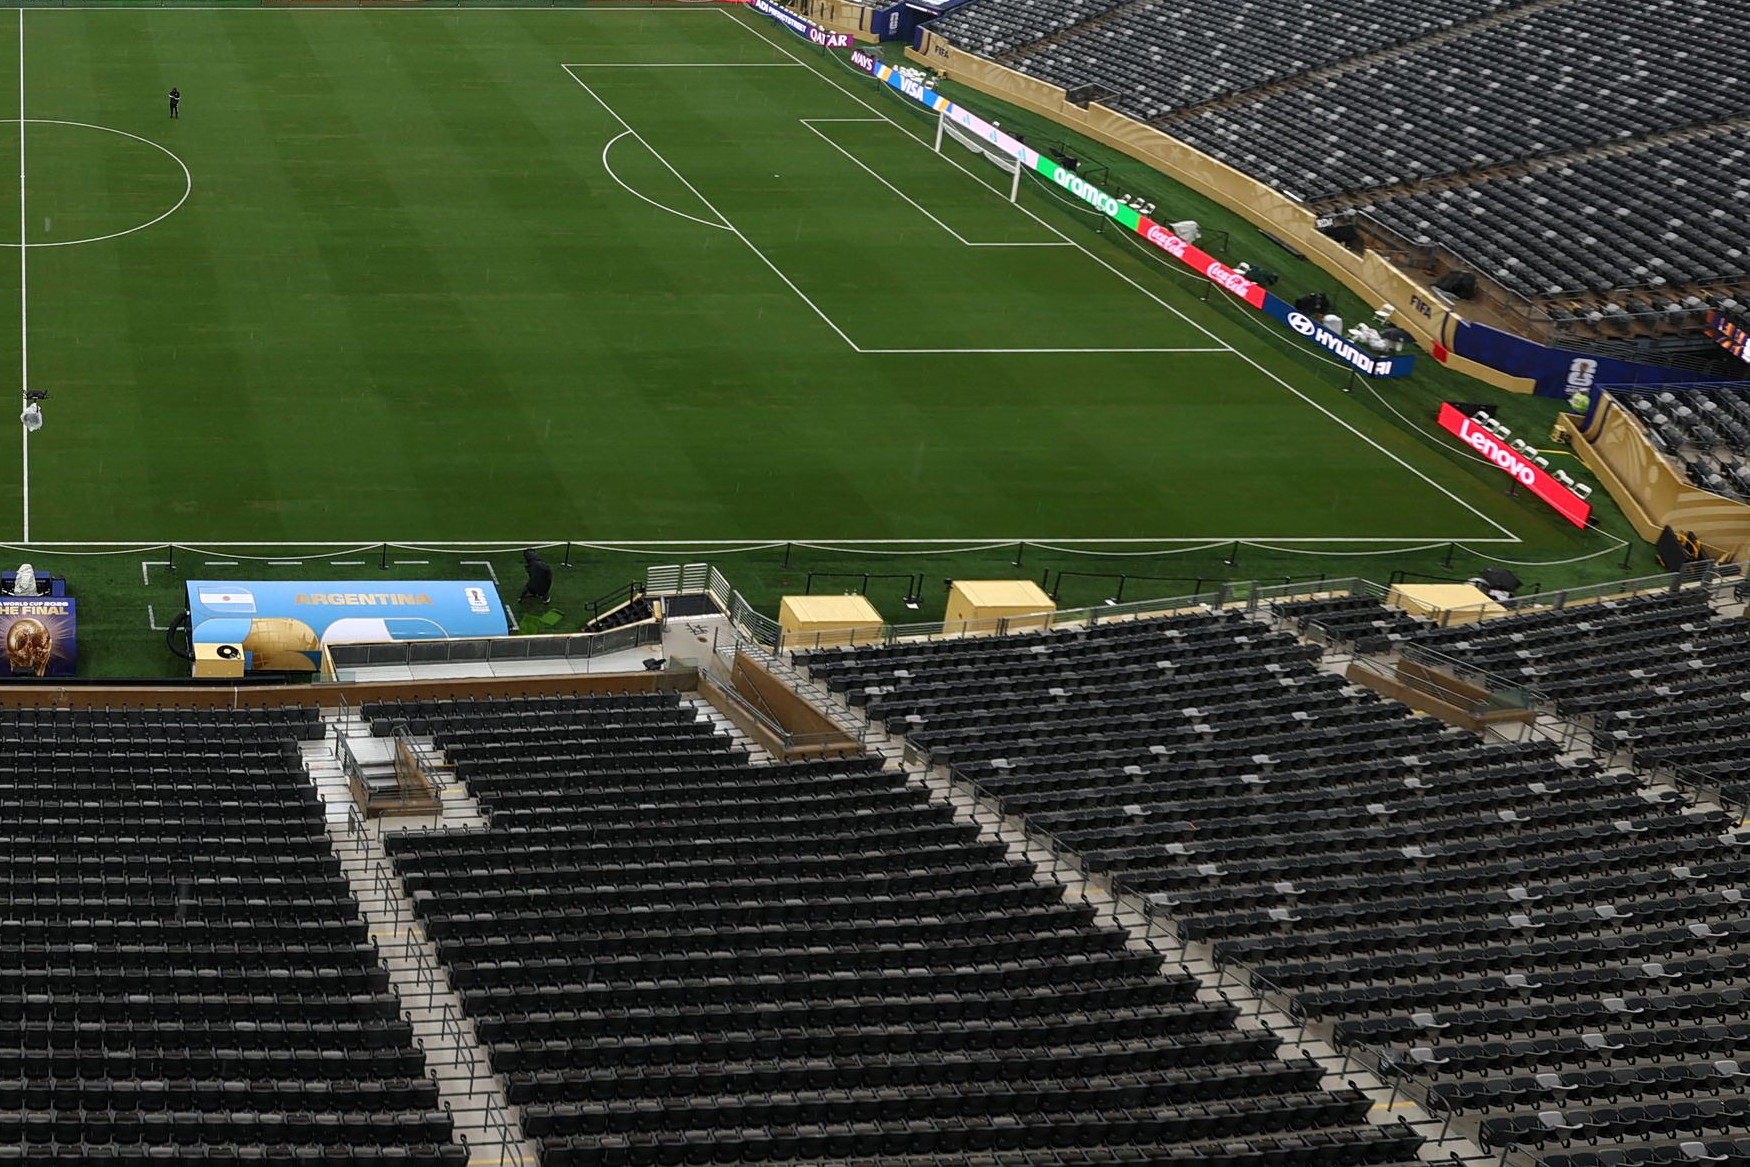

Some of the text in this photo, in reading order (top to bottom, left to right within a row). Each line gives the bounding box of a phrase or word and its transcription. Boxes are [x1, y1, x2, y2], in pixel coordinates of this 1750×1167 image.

[810, 27, 873, 71] QATAR WAYS
[935, 46, 949, 59] FIFA
[900, 75, 924, 101] VISA
[1054, 167, 1119, 217] aramco
[1147, 225, 1188, 258] Coca-Cola
[1207, 262, 1248, 297] Coca-Cola
[1410, 295, 1432, 319] FIFA
[1315, 328, 1392, 375] HYUNDAI
[1459, 419, 1535, 485] Lenovo
[22, 606, 69, 615] FINAL
[294, 593, 433, 606] ARGENTINA
